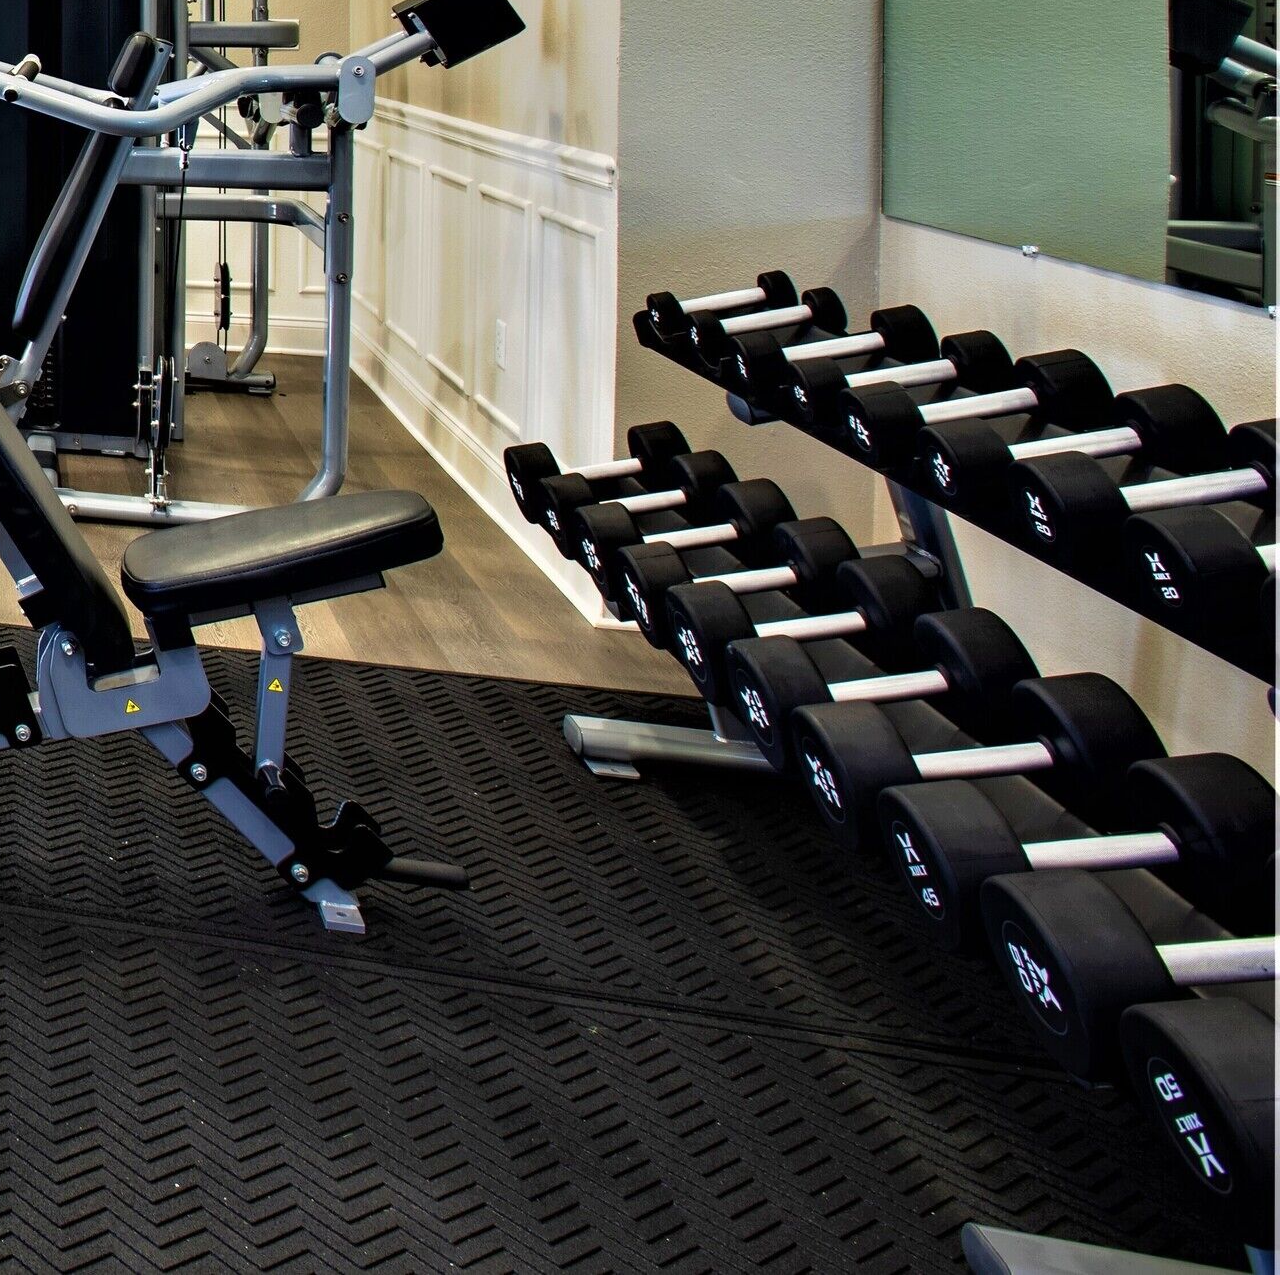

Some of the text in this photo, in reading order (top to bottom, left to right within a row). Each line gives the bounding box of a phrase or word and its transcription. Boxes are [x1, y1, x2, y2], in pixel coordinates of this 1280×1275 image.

[1161, 586, 1180, 600] 20
[922, 887, 940, 907] 45
[1154, 1072, 1184, 1102] 50
[1175, 1113, 1204, 1134] XULT
